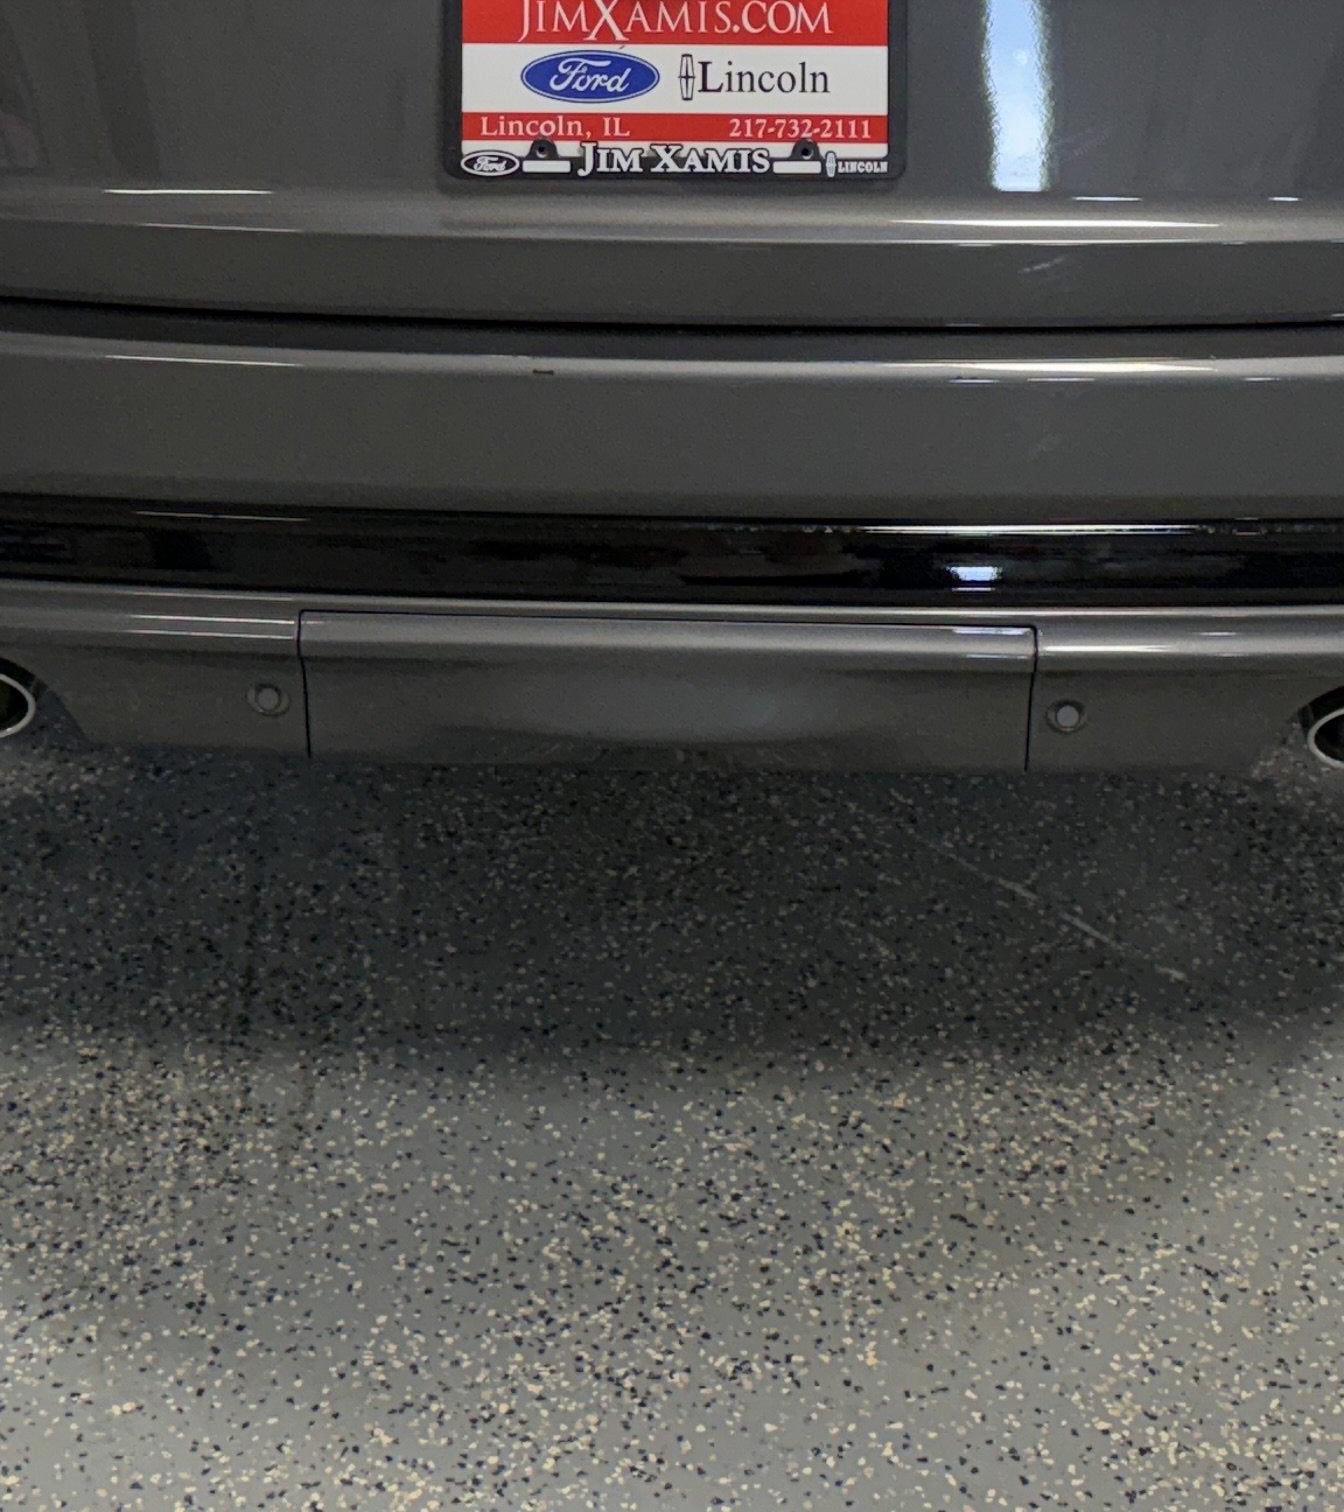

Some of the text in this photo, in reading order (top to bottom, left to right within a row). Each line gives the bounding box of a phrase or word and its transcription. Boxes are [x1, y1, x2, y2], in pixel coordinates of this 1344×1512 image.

[549, 56, 633, 92] Ford
[698, 60, 830, 94] Lincoln
[480, 116, 630, 138] Lincoln, IL
[729, 118, 871, 138] 217-732-2111
[577, 141, 771, 178] JIM XAMIS
[837, 161, 888, 173] LINCOLN
